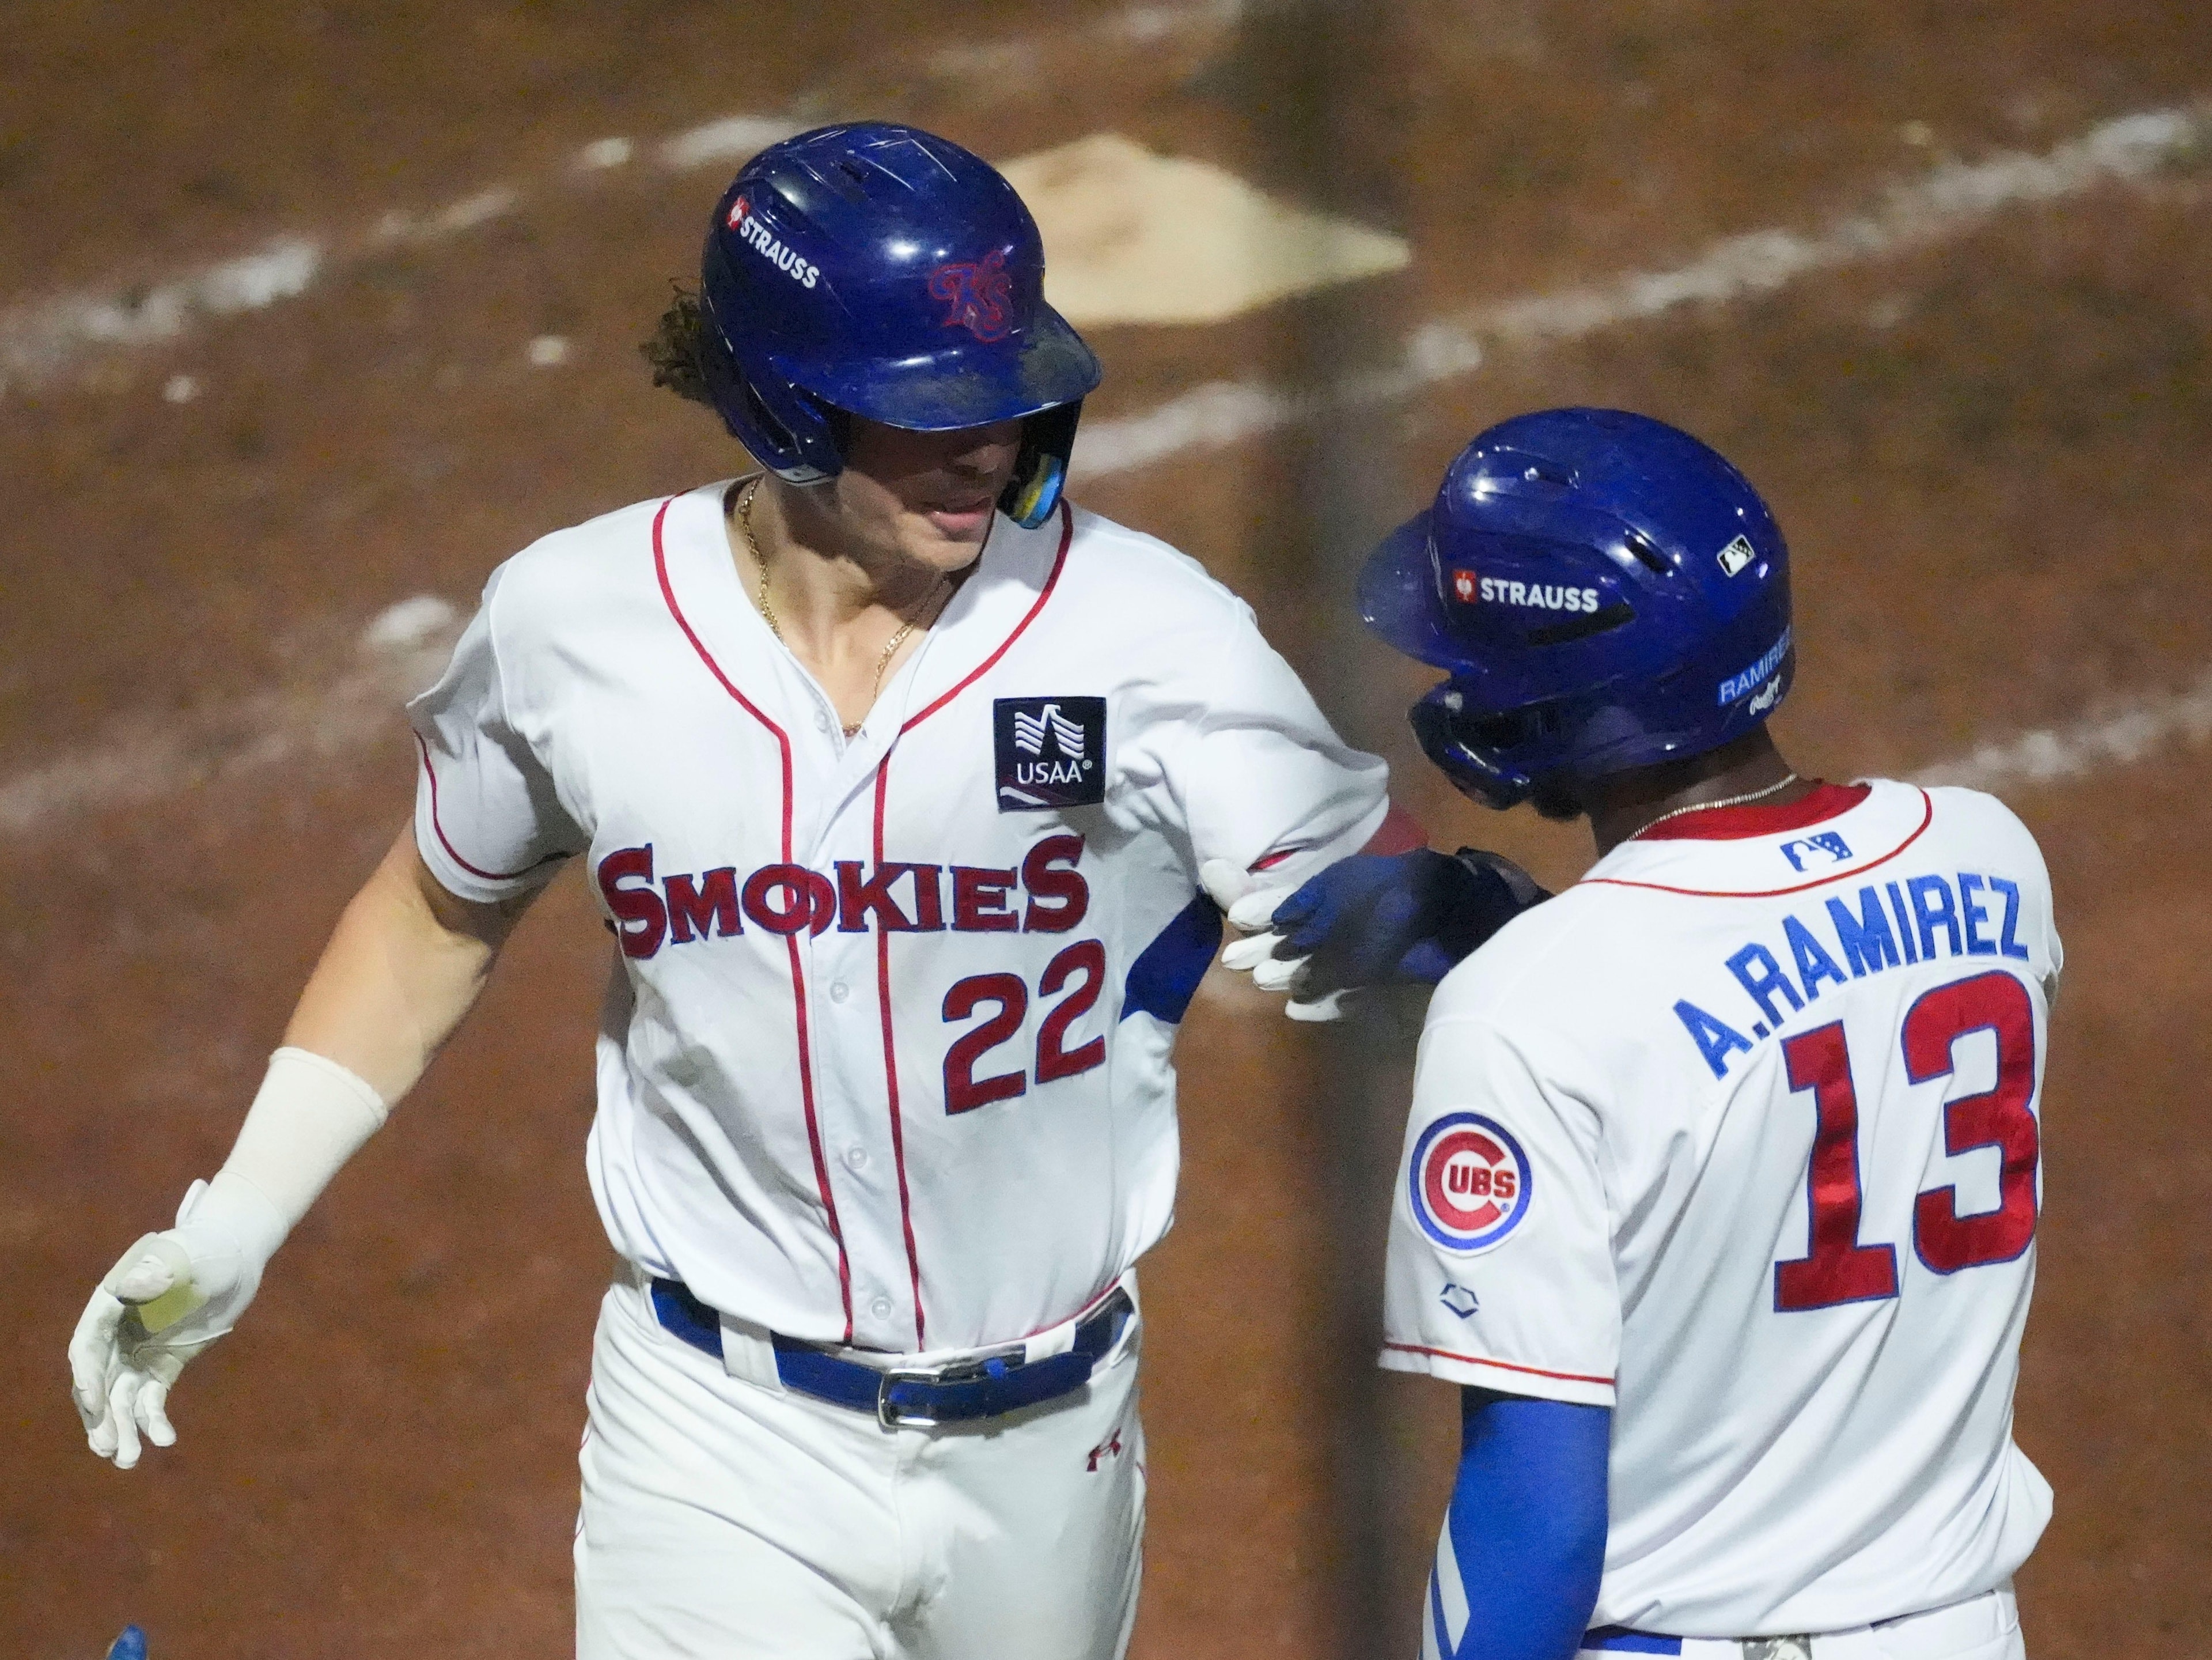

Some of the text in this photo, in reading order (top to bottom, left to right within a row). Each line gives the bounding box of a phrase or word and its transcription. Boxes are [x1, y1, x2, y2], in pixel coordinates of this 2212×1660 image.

[740, 216, 820, 288] STRAUSS
[1480, 578, 1599, 613] STRAUSS
[597, 834, 1089, 960] SMOKIES
[942, 939, 1107, 1116] 22
[1673, 872, 2029, 1081] A.RAMIREZ
[1425, 1130, 1516, 1231] CUBS
[1774, 970, 2039, 1313] 13
